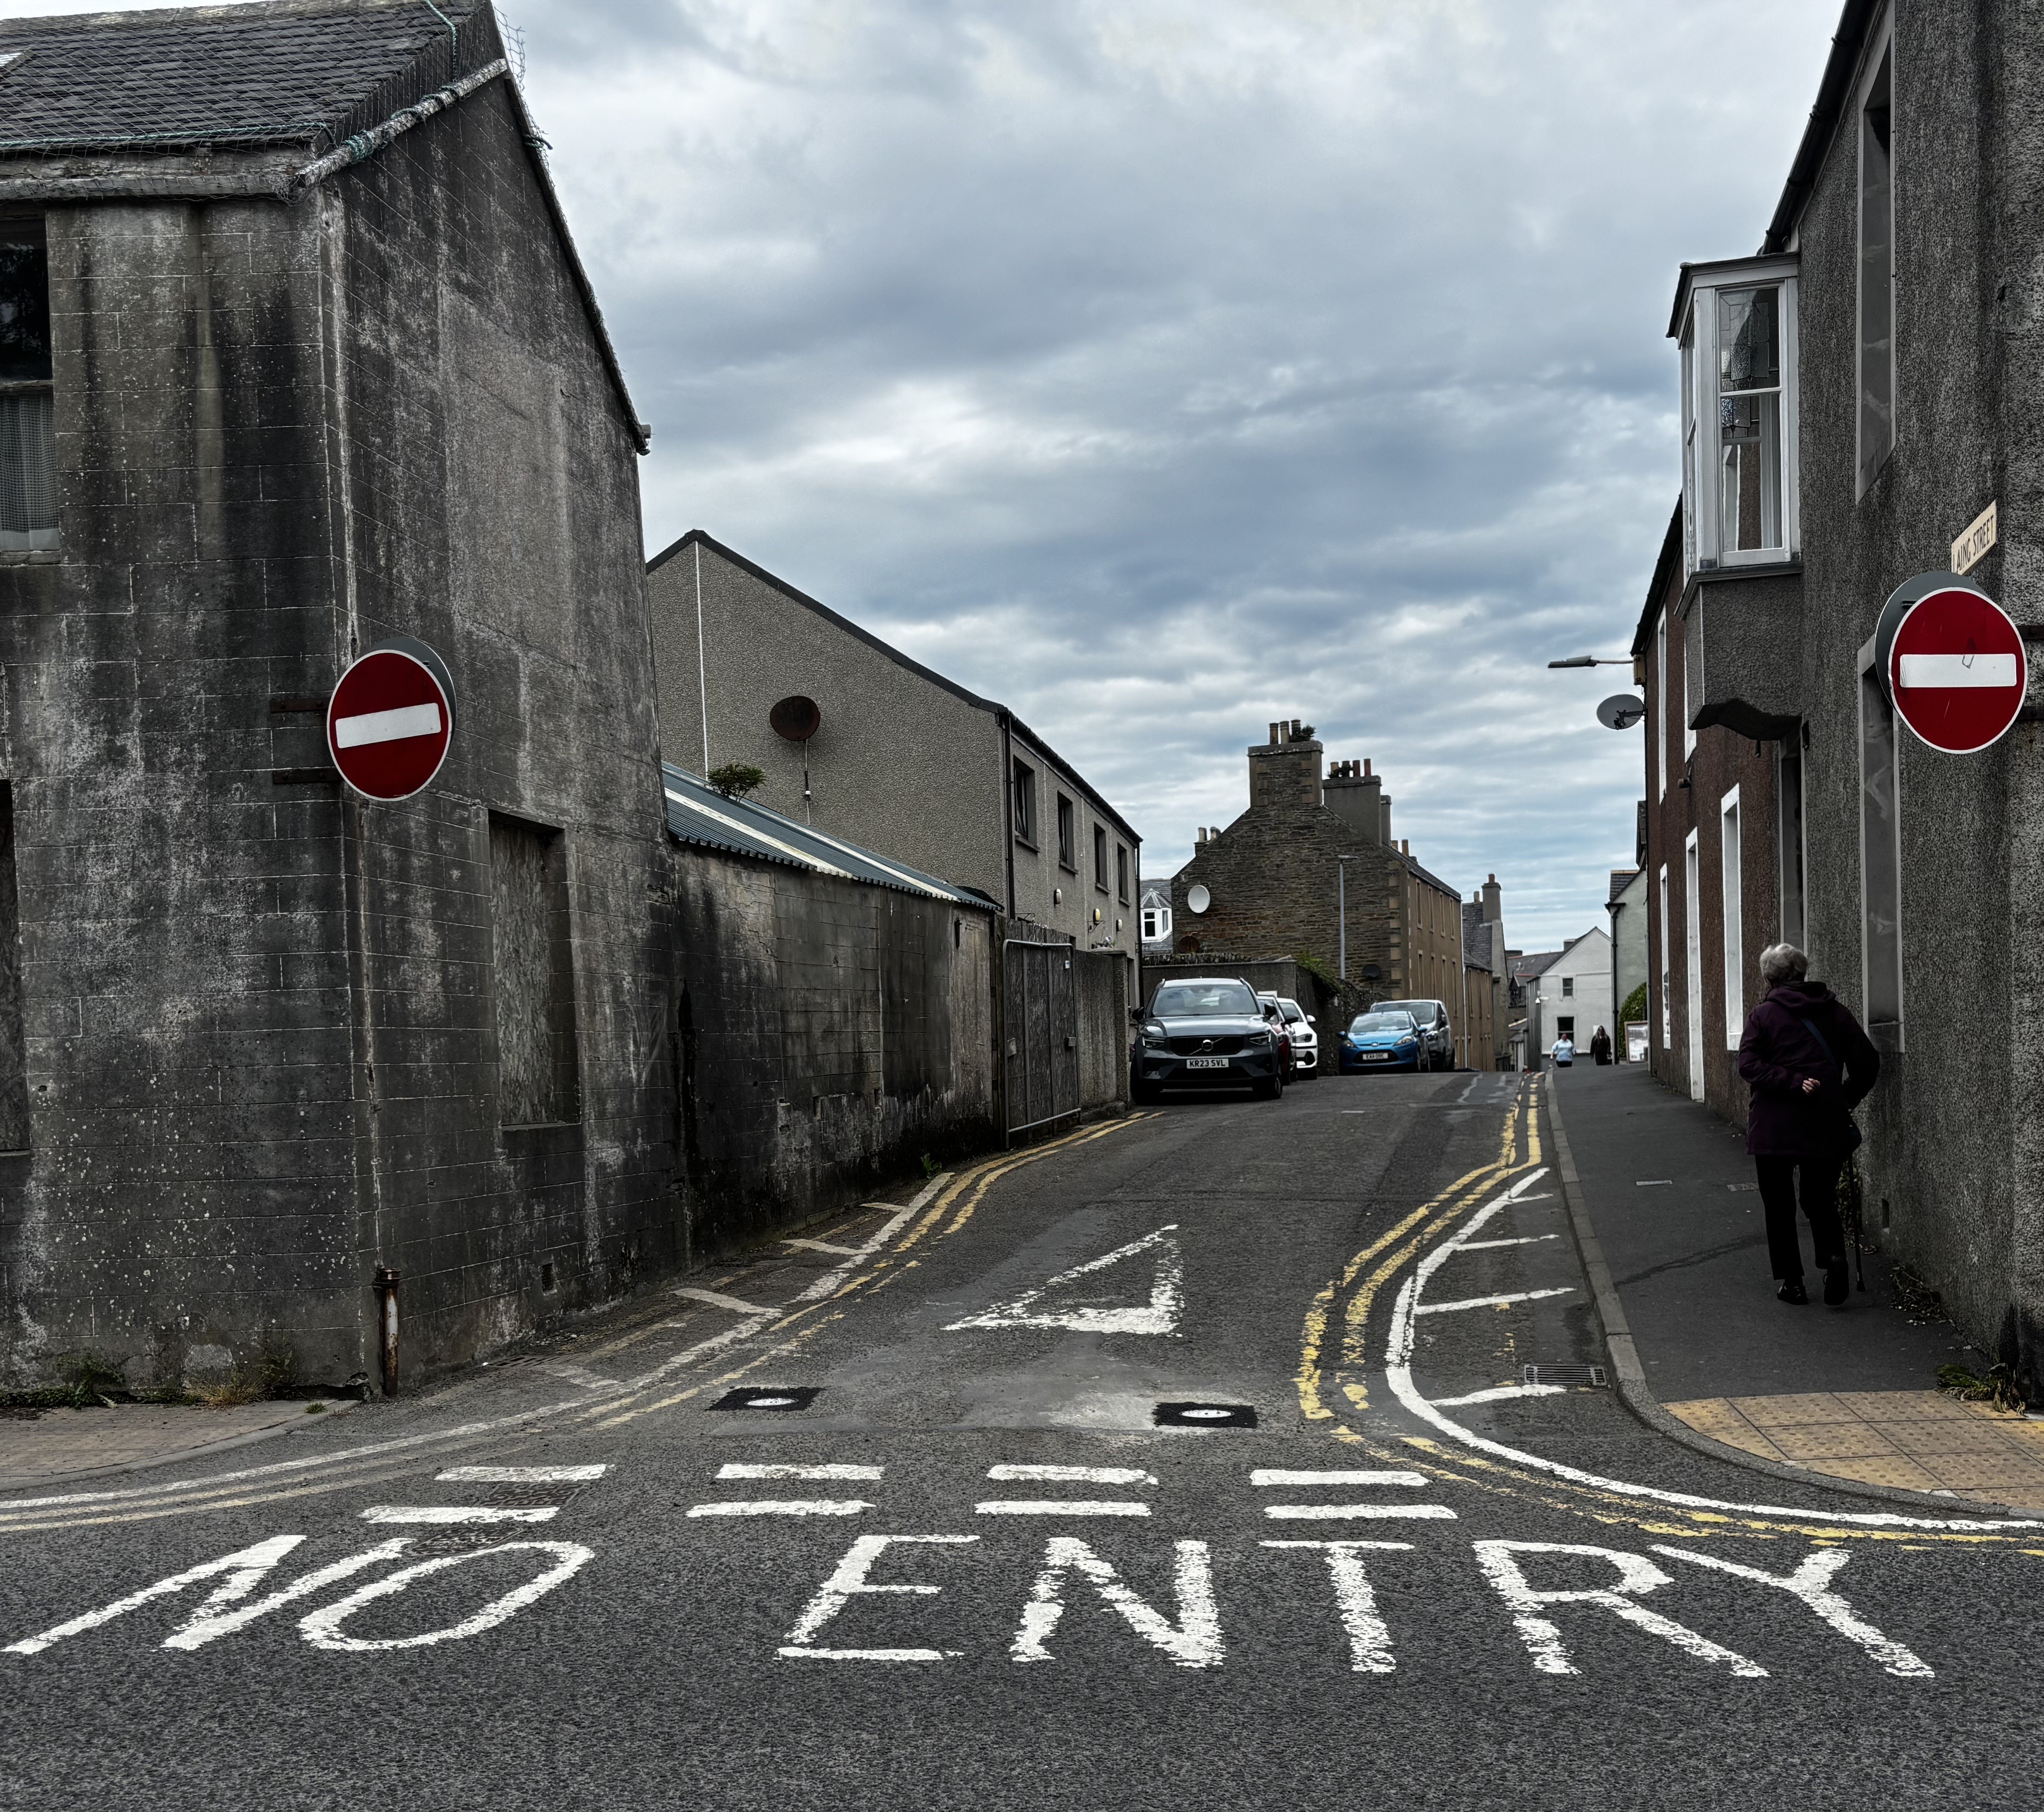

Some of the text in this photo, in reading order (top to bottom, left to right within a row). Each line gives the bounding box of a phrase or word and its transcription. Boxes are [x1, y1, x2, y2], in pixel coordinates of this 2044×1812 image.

[1973, 515, 1994, 556] STREET
[1, 1534, 1935, 1677] NO ENTRY
